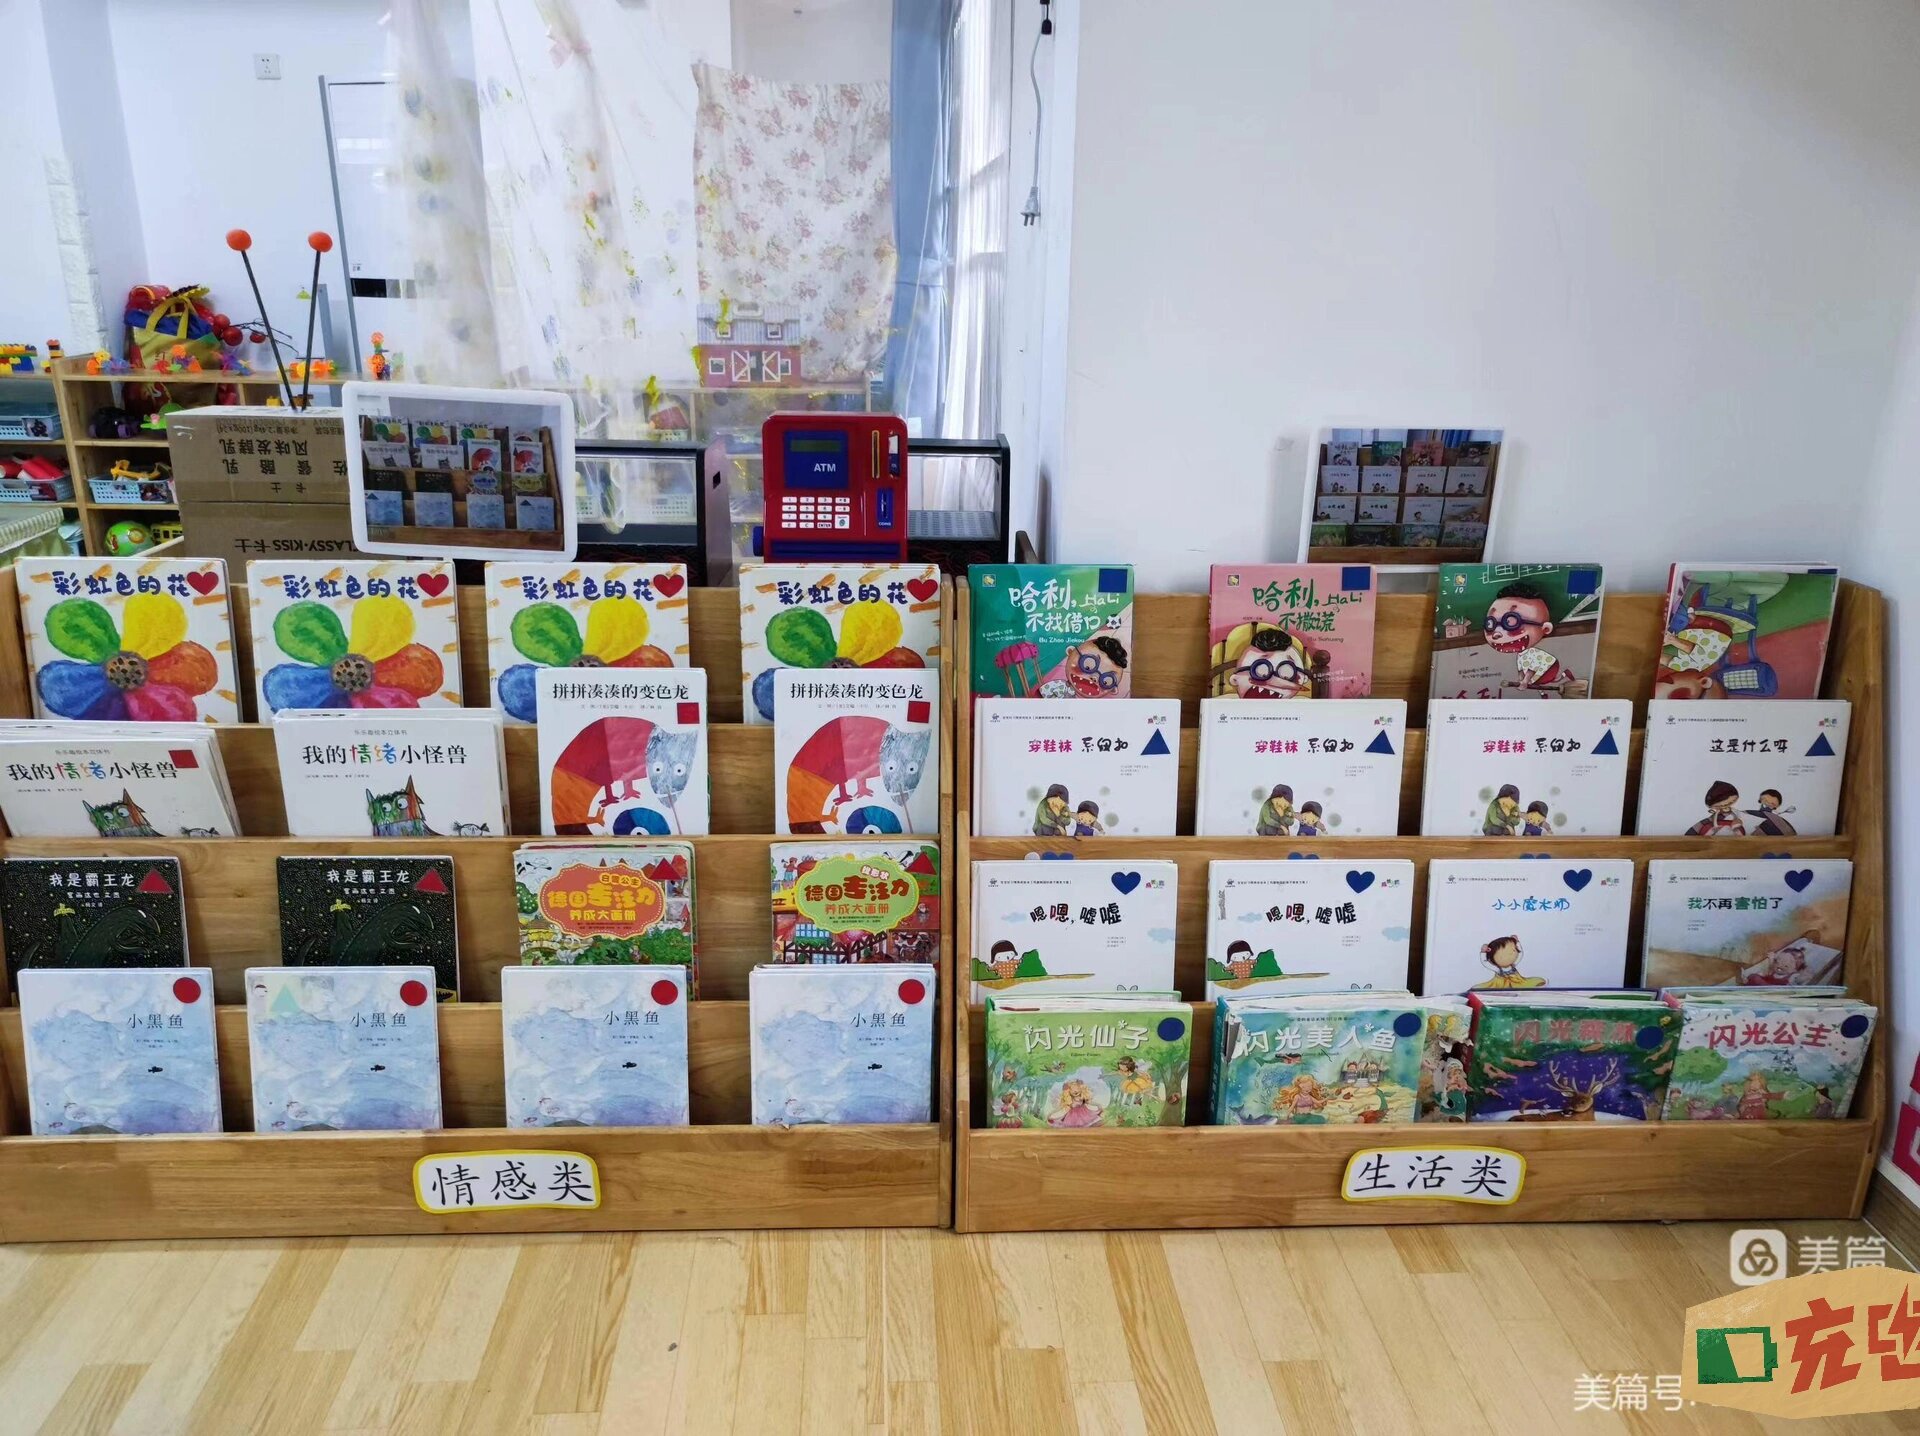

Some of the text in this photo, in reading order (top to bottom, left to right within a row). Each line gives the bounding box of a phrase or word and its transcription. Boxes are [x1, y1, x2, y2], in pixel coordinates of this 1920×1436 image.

[219, 439, 308, 456] 风味发酵乳
[223, 459, 348, 476] 佐餐酪乳
[813, 463, 836, 472] ATM
[271, 482, 307, 493] 卡士
[235, 539, 358, 553] 卡士 LASSY·KISS
[53, 571, 190, 597] 彩虹色的花
[283, 575, 420, 600] 彩虹色的花
[522, 576, 654, 601] 彩虹色的花
[778, 581, 908, 605] 彩虹色的花
[1026, 612, 1101, 633] 不找借口
[1278, 612, 1336, 633] 不撒谎
[552, 683, 689, 700] 拼拼凑凑的变色龙
[791, 683, 923, 699] 拼拼凑凑的变色龙
[1028, 738, 1073, 753] 穿鞋袜
[1255, 739, 1299, 753] 穿鞋袜
[1483, 739, 1526, 753] 穿鞋袜
[1709, 738, 1788, 754] 这是什么呀
[302, 743, 467, 765] 我的情绪小怪兽
[6, 760, 178, 781] 我的情绪小怪兽
[49, 872, 135, 887] 我是霸王龙
[327, 869, 410, 883] 我是霸王龙
[825, 903, 890, 915] 养成大画册
[1492, 895, 1570, 912] 小小魔术师
[1688, 896, 1783, 911] 我不再害怕了
[570, 910, 636, 921] 养成大画册
[127, 1014, 184, 1029] 小黑鱼
[350, 1012, 407, 1028] 小黑鱼
[603, 1011, 660, 1026] 小黑鱼
[850, 1012, 906, 1028] 小黑鱼
[1023, 1020, 1149, 1054] 闪光仙子
[1242, 1023, 1398, 1056] 闪光美人鱼
[1709, 1022, 1832, 1049] 闪光公主
[431, 1160, 594, 1206] 情感类
[1353, 1153, 1508, 1198] 生活类
